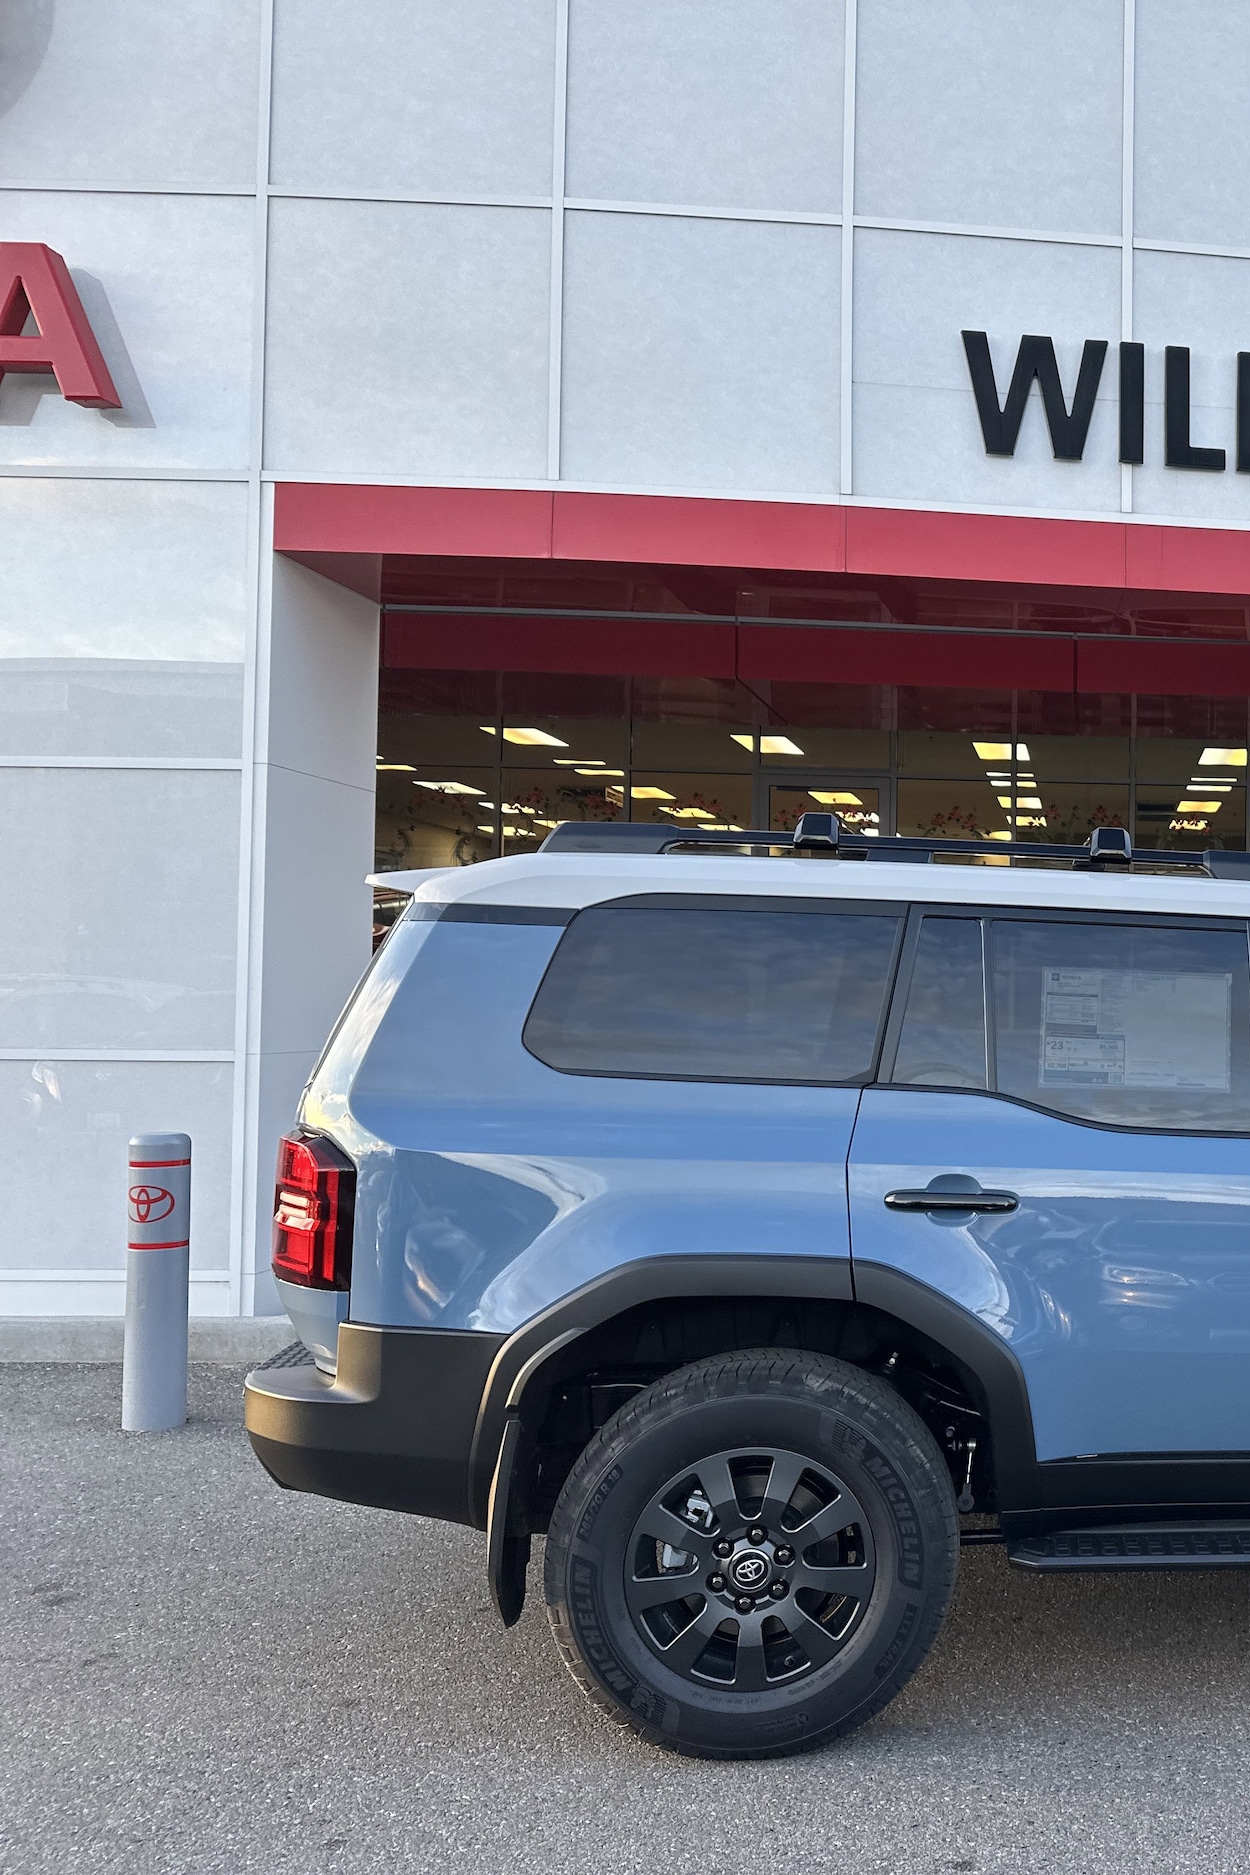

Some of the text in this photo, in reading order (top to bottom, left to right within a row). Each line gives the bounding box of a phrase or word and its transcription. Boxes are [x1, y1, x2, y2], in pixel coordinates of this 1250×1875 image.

[1050, 1040, 1064, 1050] 23
[864, 1455, 921, 1583] MICHELIN
[573, 1562, 634, 1692] MICHELIN
